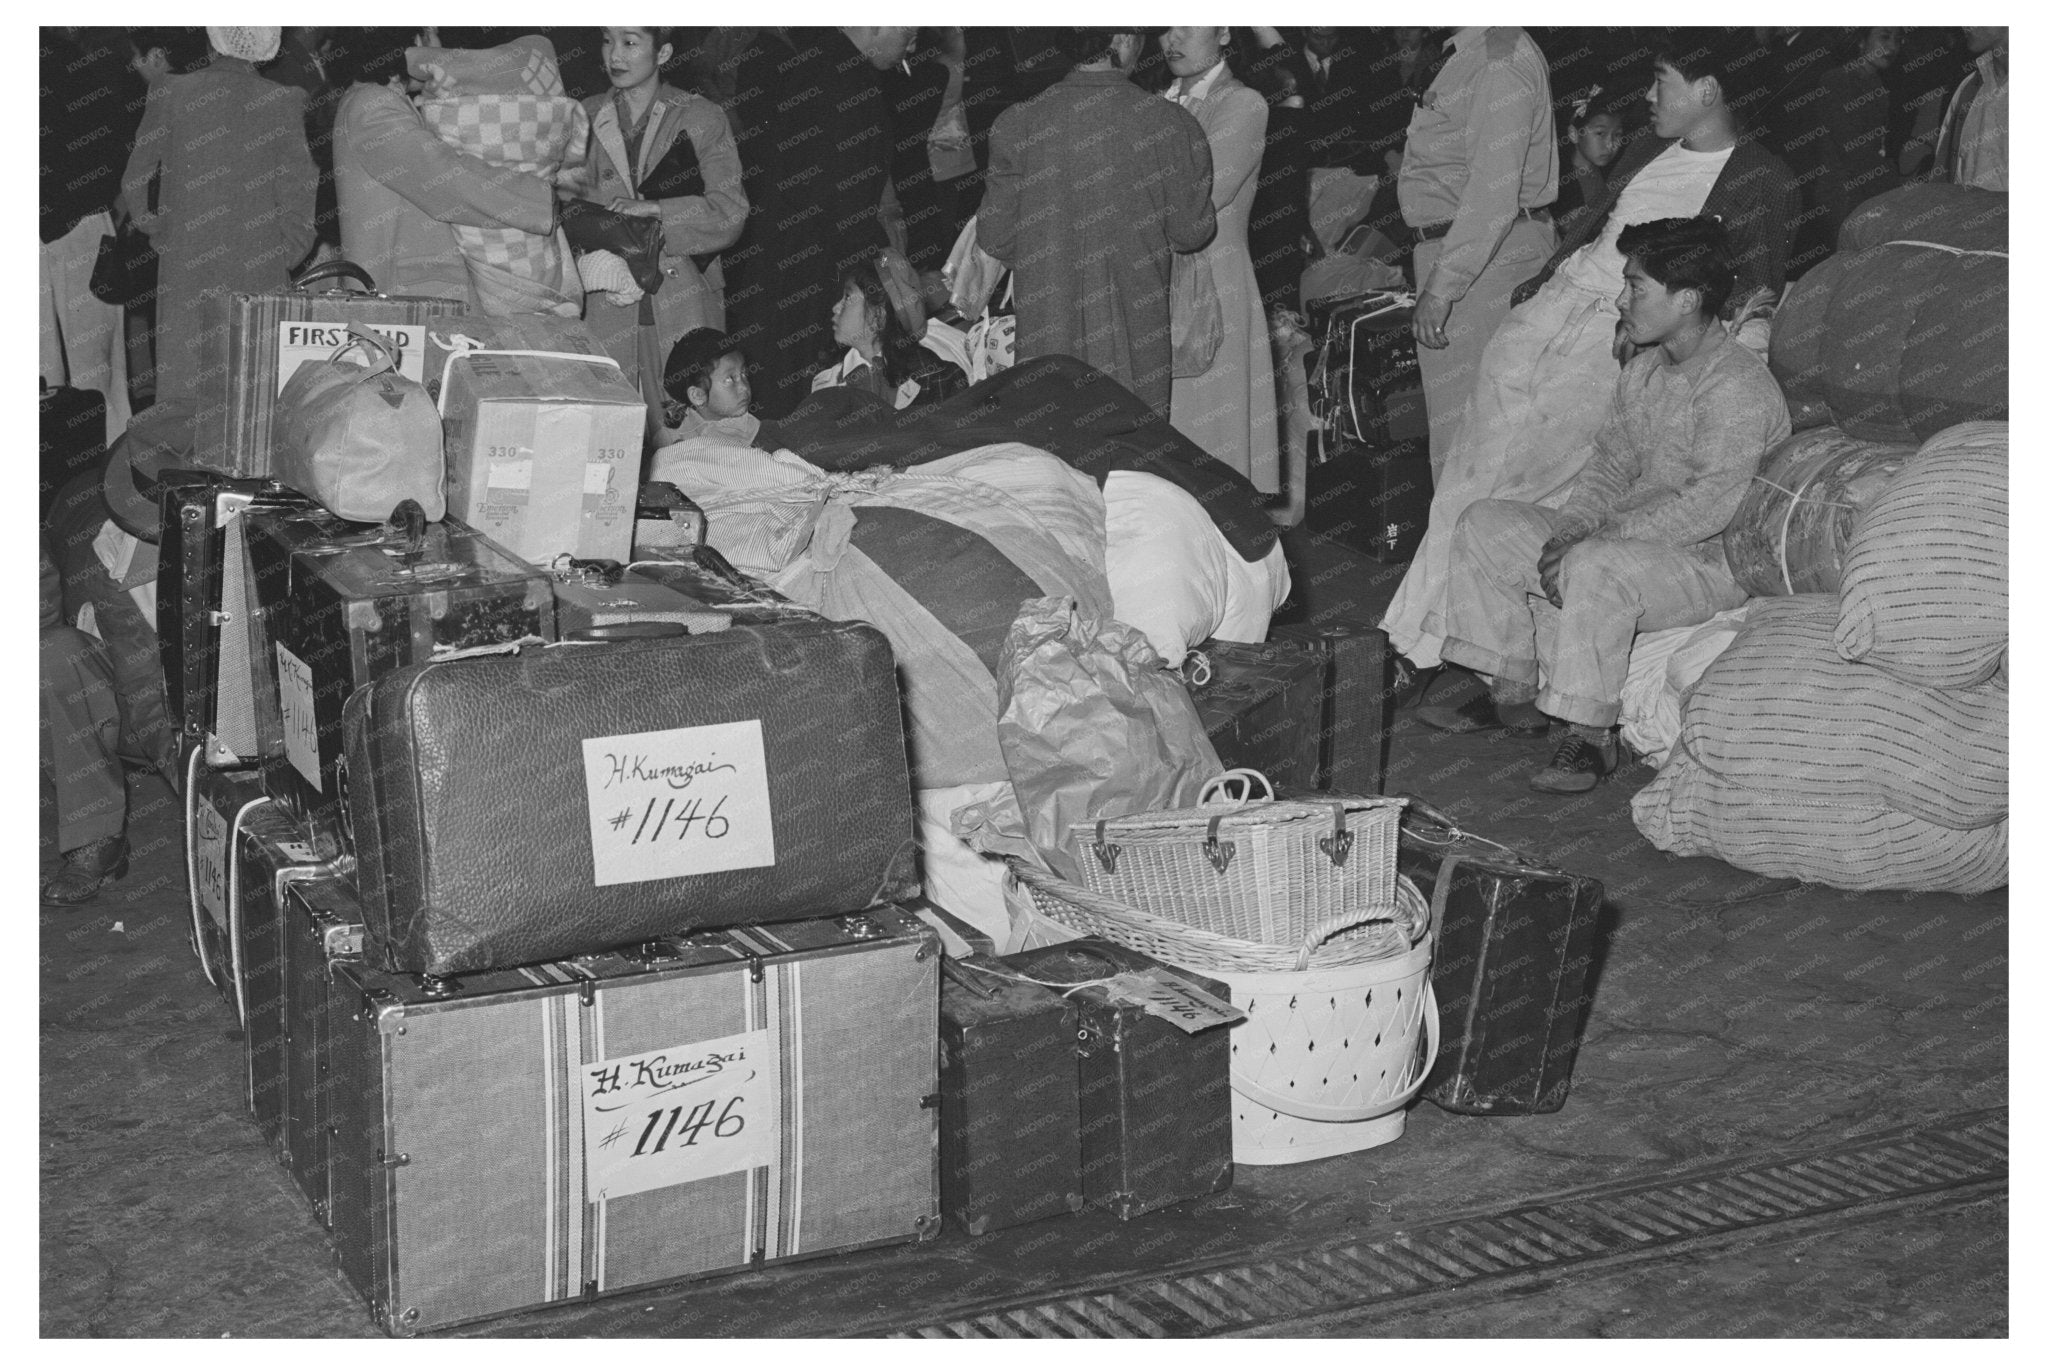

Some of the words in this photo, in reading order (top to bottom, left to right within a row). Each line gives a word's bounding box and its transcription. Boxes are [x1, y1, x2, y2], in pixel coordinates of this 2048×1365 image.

[488, 446, 517, 458] 330
[597, 448, 626, 460] 330
[607, 795, 730, 846] #1146
[598, 1096, 746, 1159] #1146
